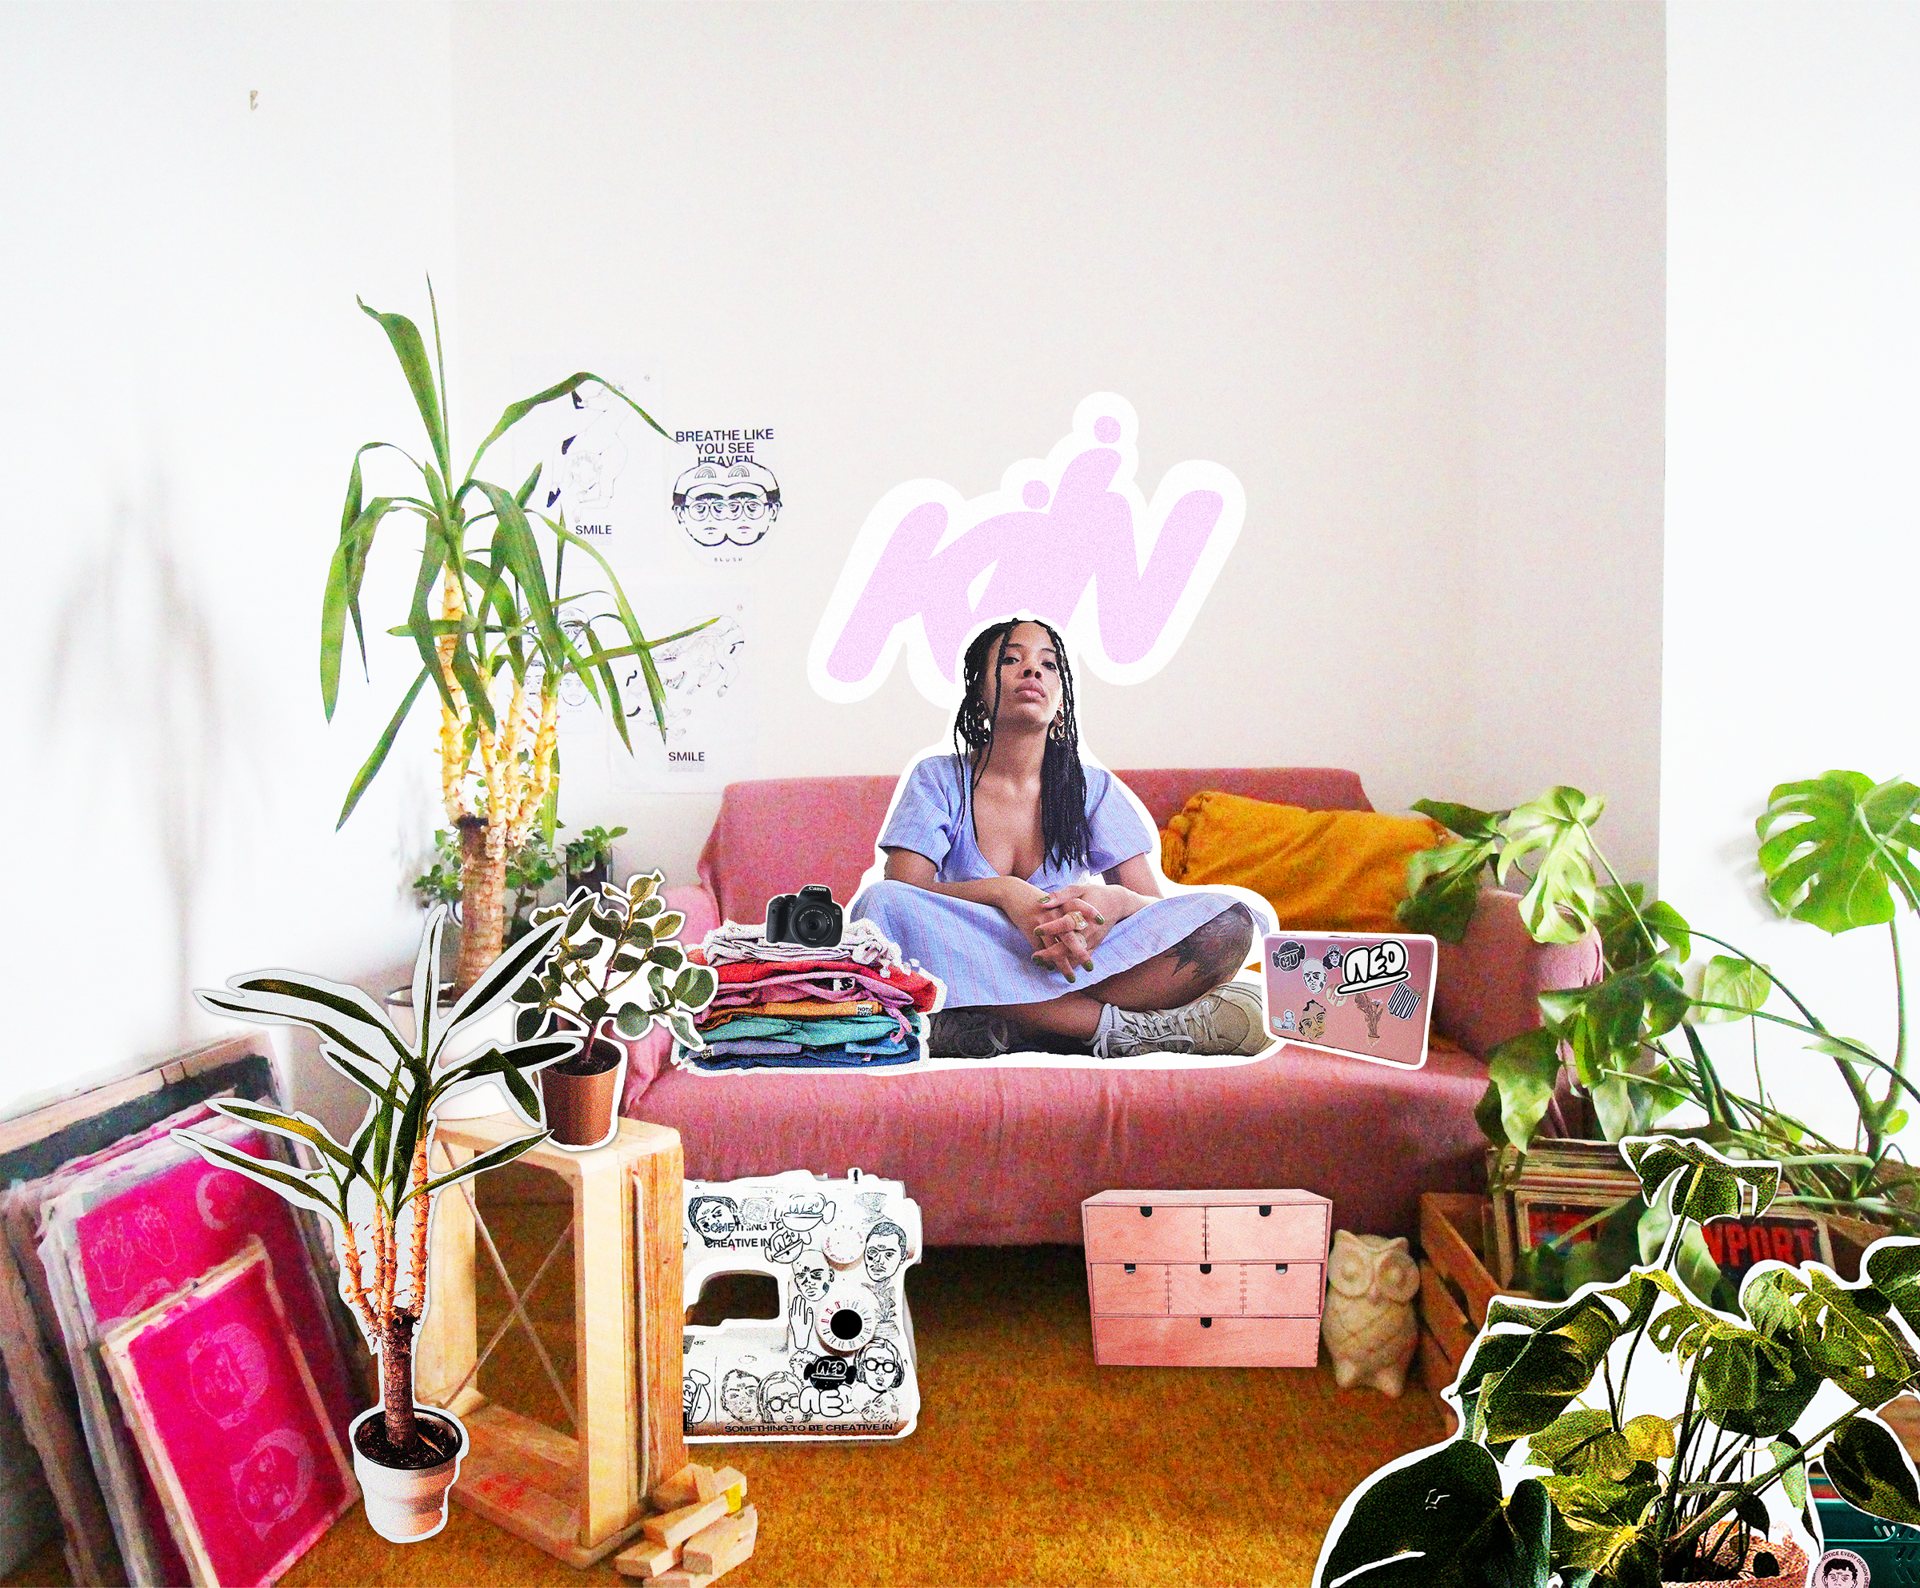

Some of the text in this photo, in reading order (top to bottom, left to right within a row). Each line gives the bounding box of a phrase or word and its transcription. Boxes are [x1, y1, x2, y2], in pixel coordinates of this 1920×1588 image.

[675, 428, 775, 442] BREATHE LIKE
[696, 442, 755, 454] YOU SEE
[575, 524, 612, 535] SMILE
[668, 751, 705, 761] SMILE
[705, 1238, 771, 1248] CREATIVE IN
[1821, 1551, 1840, 1561] NOTICE
[1840, 1551, 1858, 1560] EVERY
[1856, 1558, 1868, 1576] DESIGN
